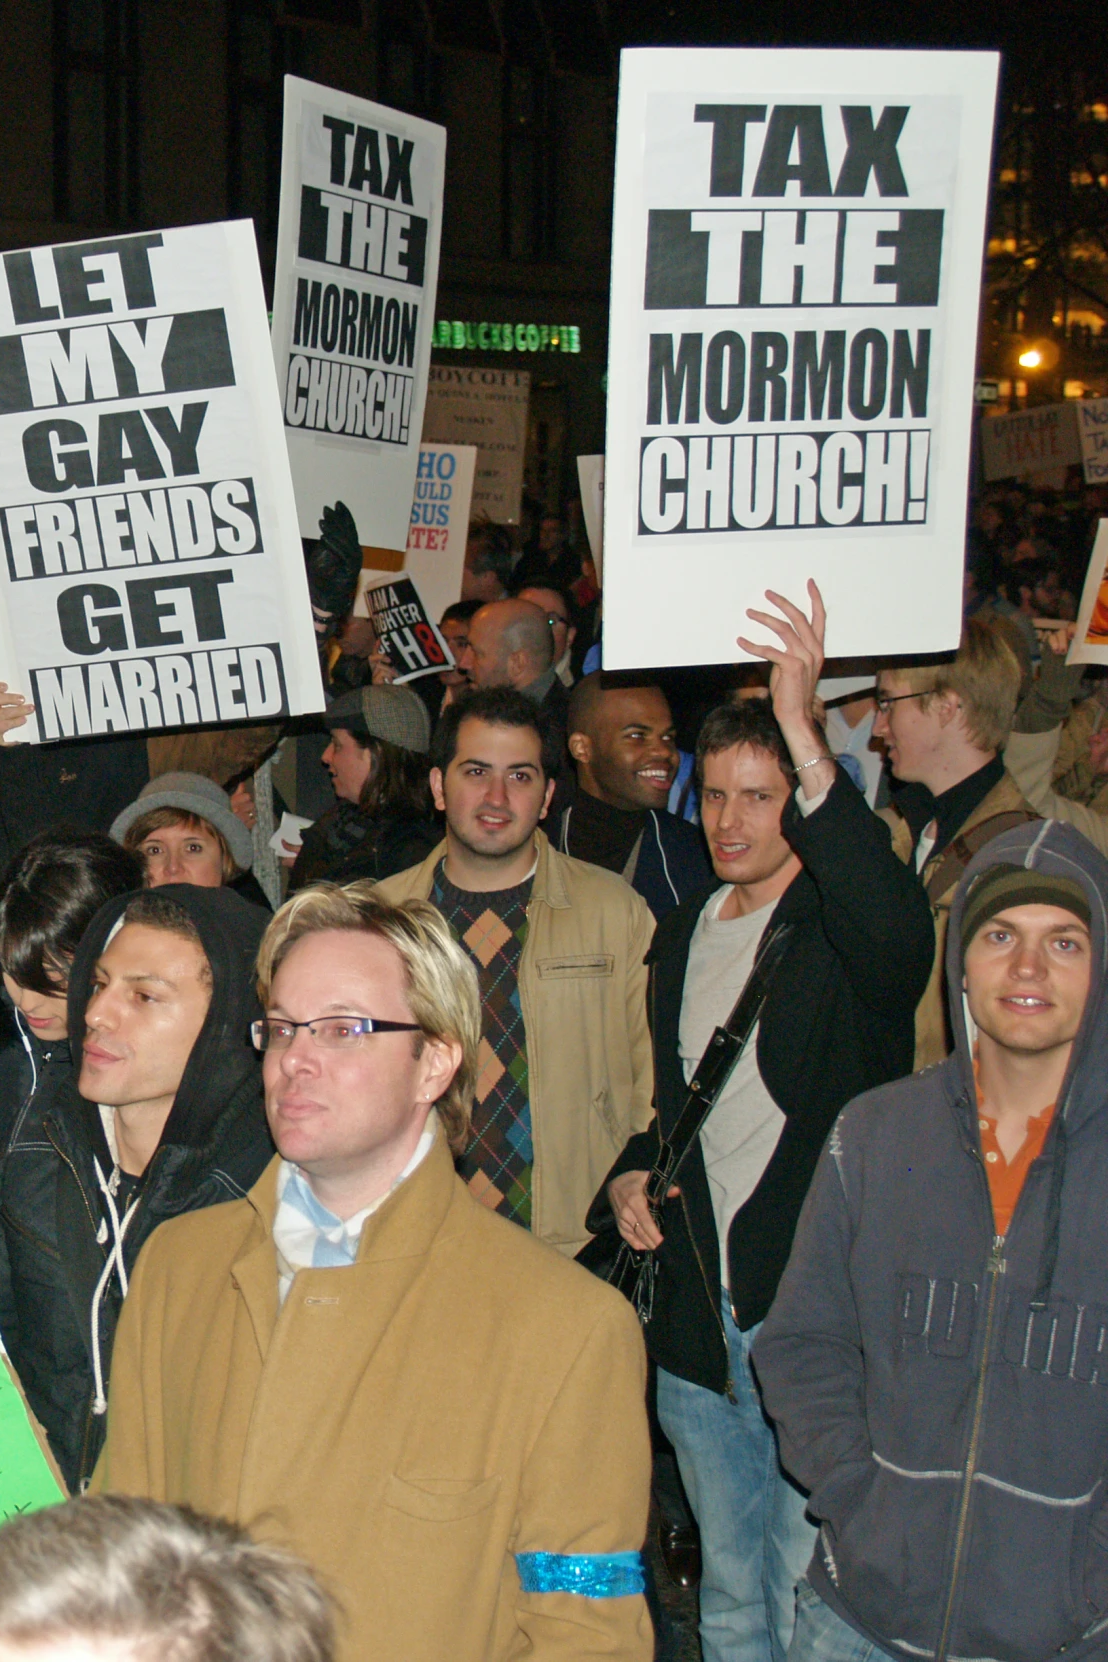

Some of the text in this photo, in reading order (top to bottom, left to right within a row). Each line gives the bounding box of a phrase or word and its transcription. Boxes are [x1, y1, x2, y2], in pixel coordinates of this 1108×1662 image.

[322, 114, 415, 206] TAX
[693, 103, 911, 198] TAX
[3, 232, 164, 326] LET
[320, 191, 412, 281] THE
[691, 211, 900, 306] THE
[21, 316, 175, 408] MY
[293, 277, 418, 368] MORMON
[285, 354, 413, 444] CHURCH!
[646, 327, 932, 426] MORMON
[21, 401, 210, 494] GAY
[640, 430, 931, 533] CHURCH!
[4, 480, 258, 580] FRIENDS
[406, 527, 449, 551] TE?
[56, 569, 235, 656] GET
[390, 622, 445, 671] H8
[34, 645, 283, 740] MARRIED
